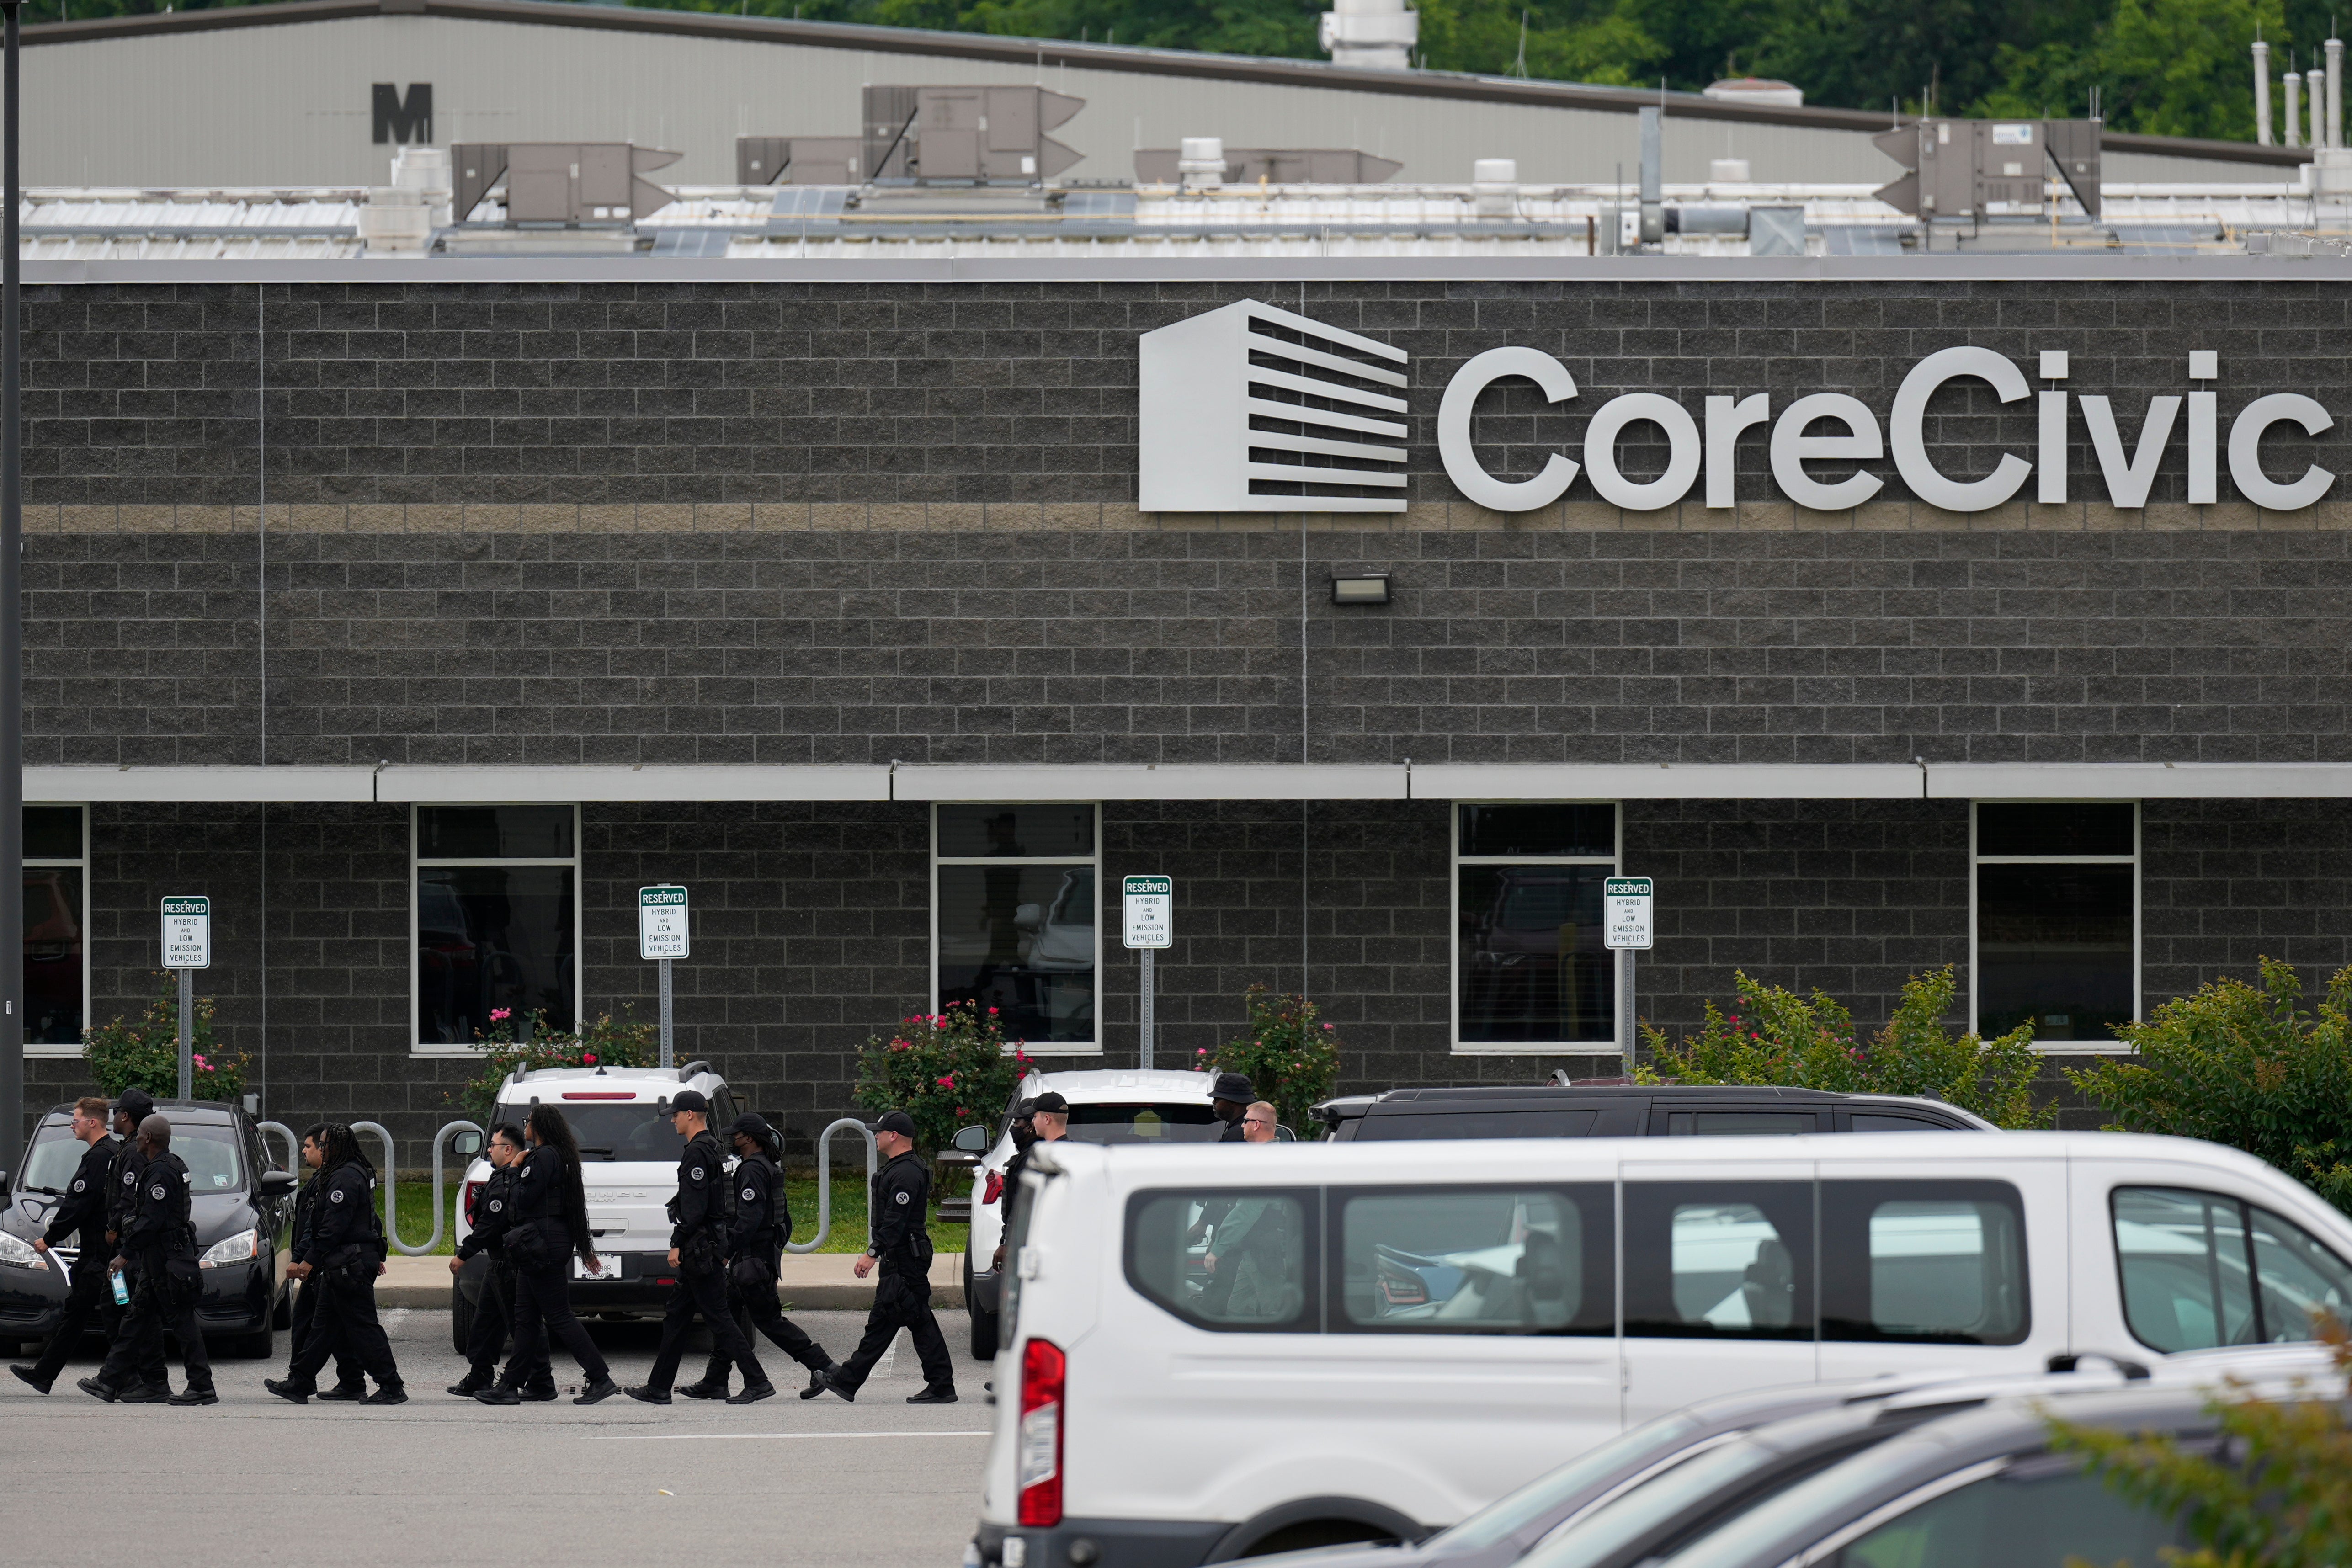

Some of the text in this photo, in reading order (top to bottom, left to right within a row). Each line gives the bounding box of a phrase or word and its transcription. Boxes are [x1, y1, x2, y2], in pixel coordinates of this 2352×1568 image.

[372, 83, 432, 144] M
[1437, 345, 2336, 512] CoreCivic
[1127, 882, 1168, 893] RESERVED
[1608, 884, 1649, 893] RESERVED
[643, 893, 684, 904] RESERVED
[165, 904, 206, 913] RESERVED
